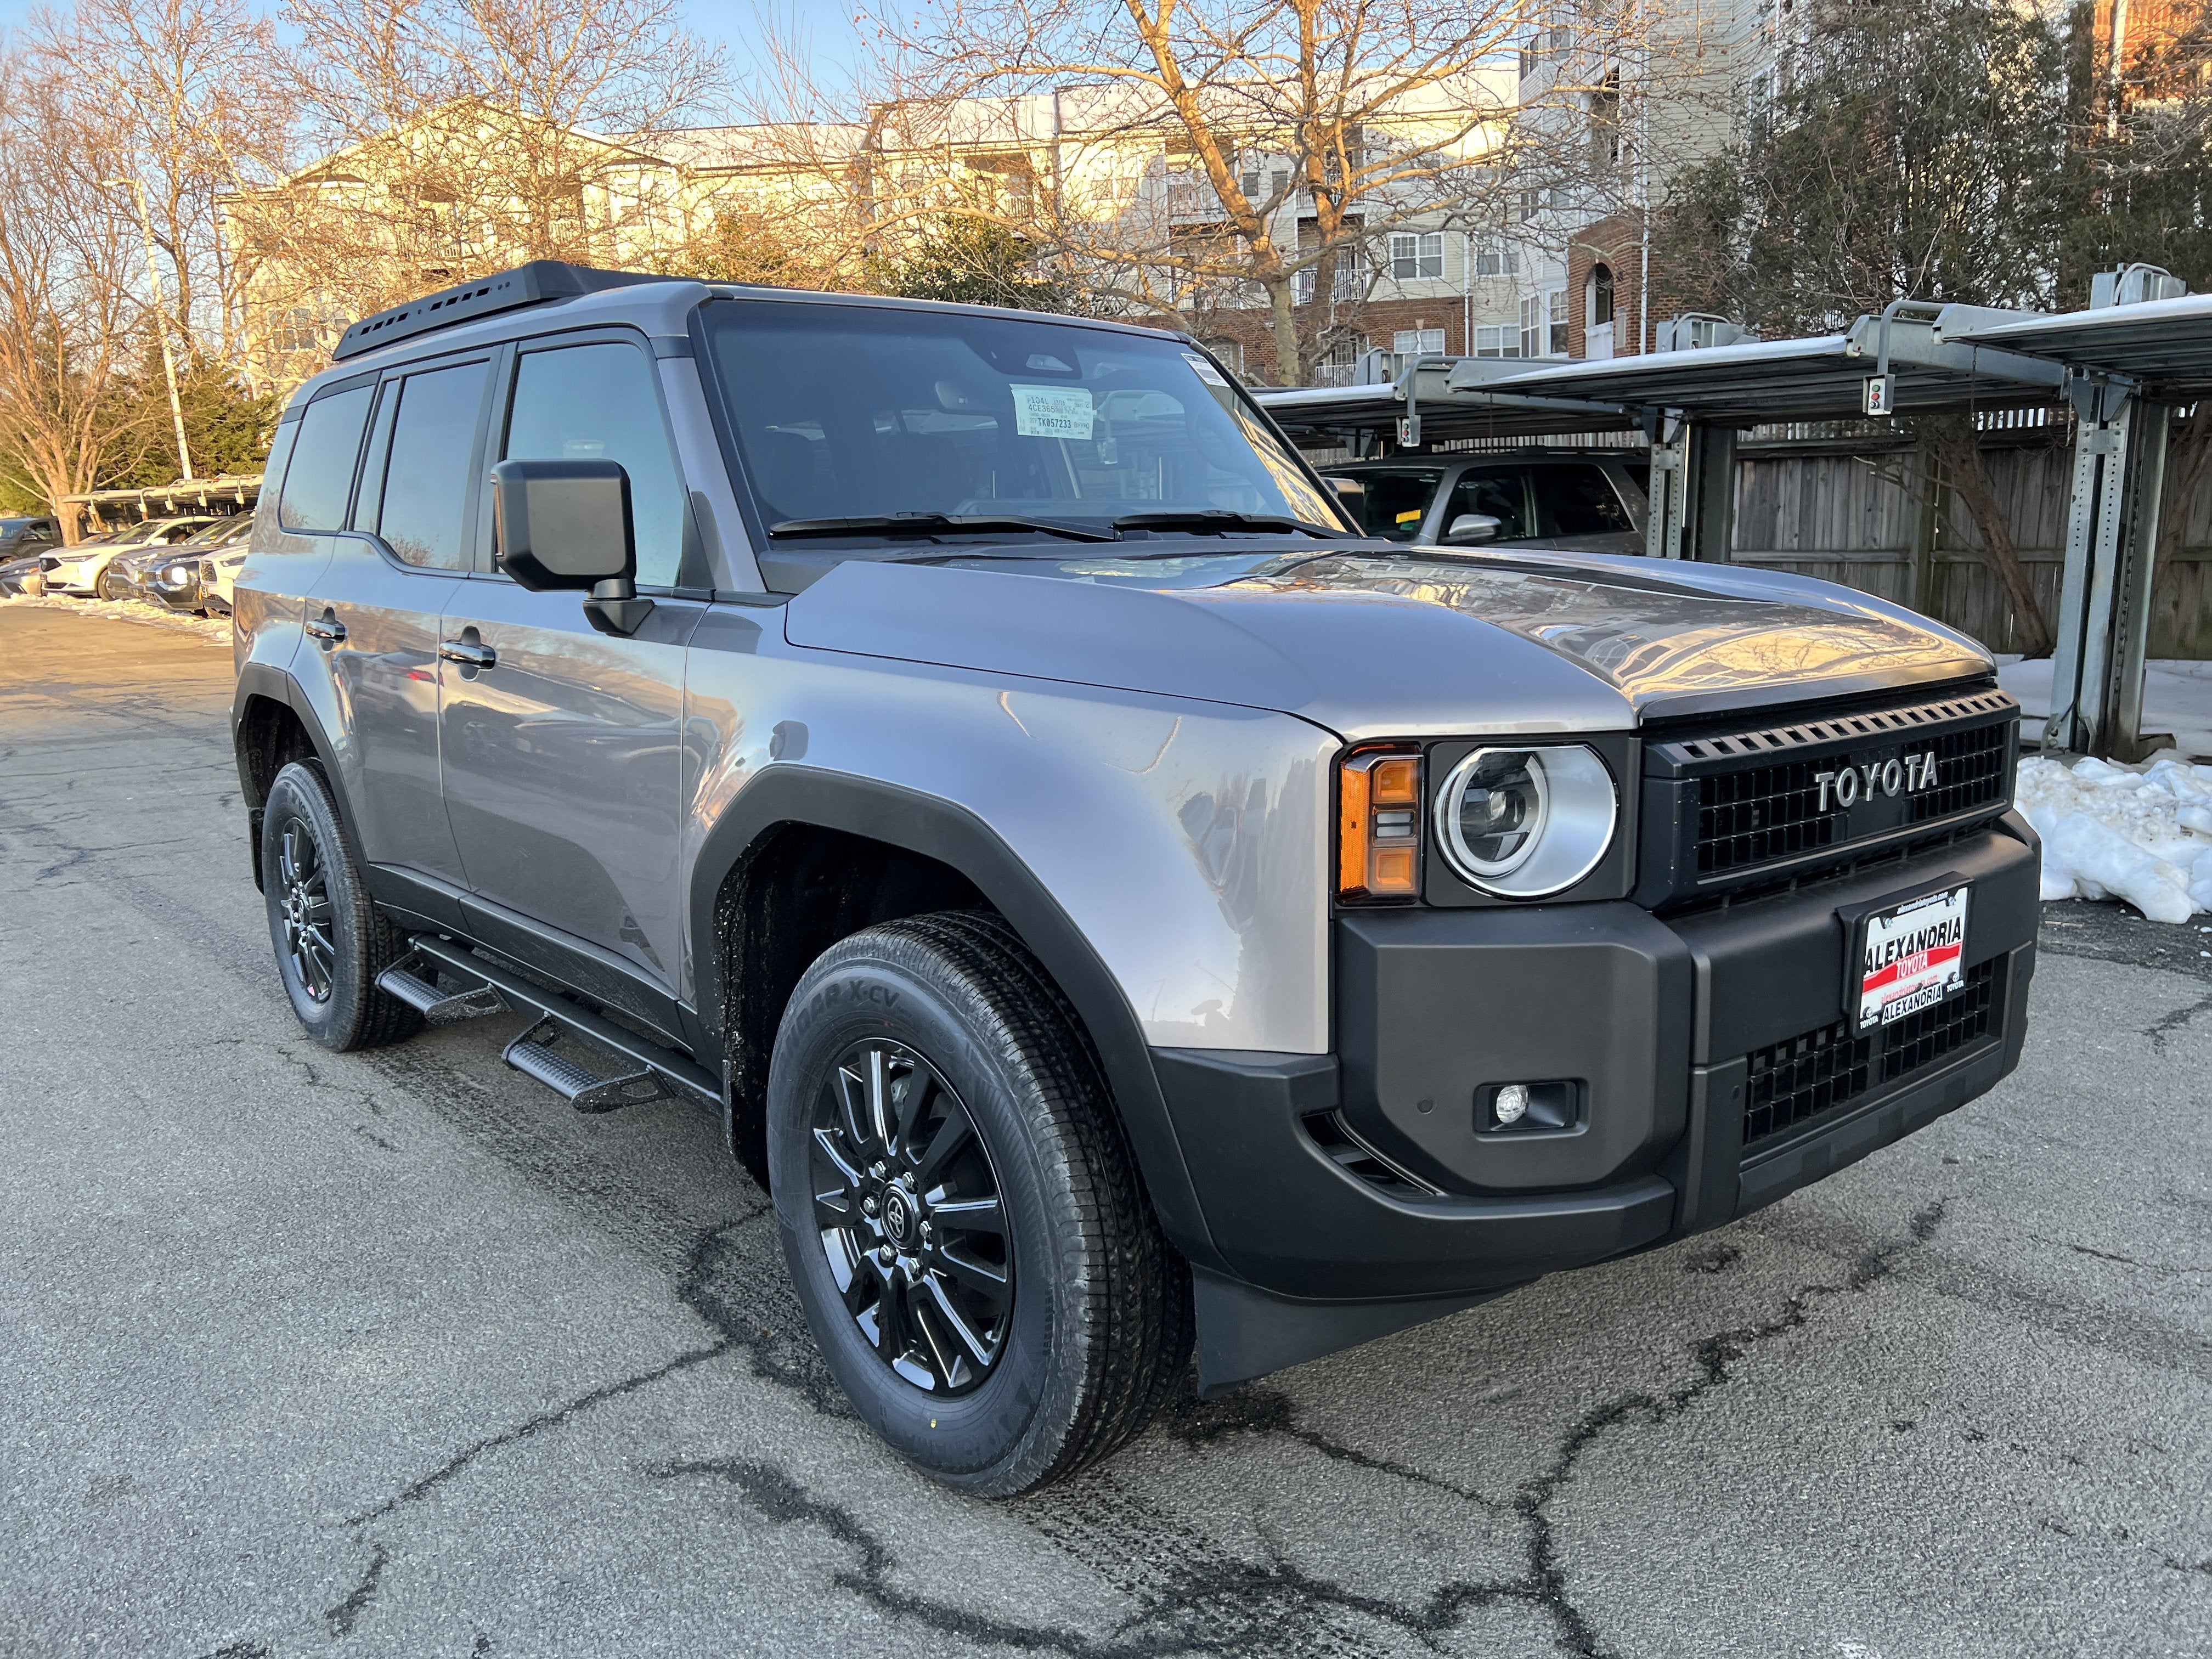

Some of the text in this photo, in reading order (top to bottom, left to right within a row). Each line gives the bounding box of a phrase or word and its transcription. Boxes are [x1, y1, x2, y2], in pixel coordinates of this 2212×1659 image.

[1029, 404, 1056, 413] 4CE365
[1037, 417, 1071, 428] TK057233
[1814, 752, 1938, 811] TOYOTA
[1865, 916, 1961, 973] ALEXANDRIA
[1897, 952, 1928, 980] TOYOTA
[1860, 980, 1964, 1029] TOYOTA ALEXANDRIA TOYOTA
